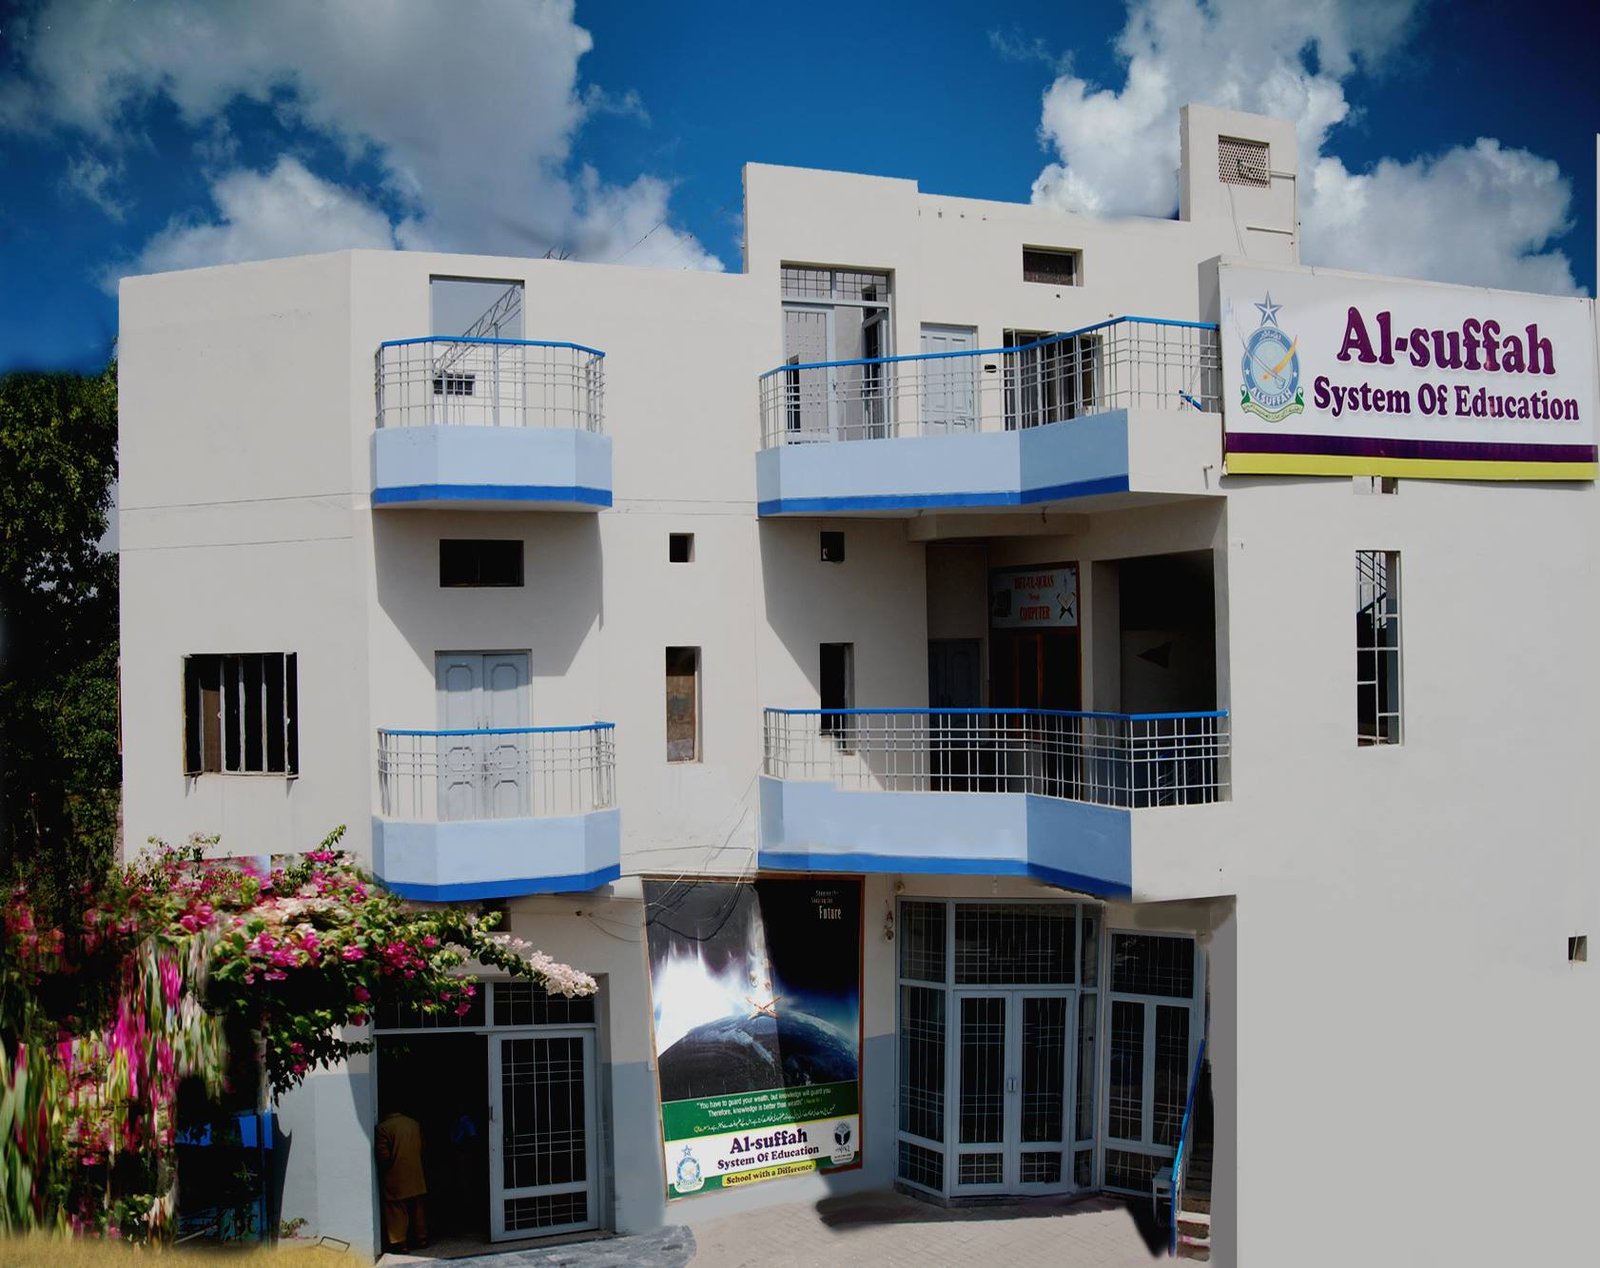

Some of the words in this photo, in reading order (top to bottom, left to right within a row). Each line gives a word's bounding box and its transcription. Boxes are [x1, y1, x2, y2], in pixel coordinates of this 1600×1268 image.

[1336, 306, 1557, 375] Al-suffah
[1313, 375, 1411, 418] System
[1417, 383, 1448, 416] Of
[1455, 385, 1580, 421] Education
[1020, 606, 1050, 620] COMPUTER
[818, 905, 842, 920] Future
[728, 1098, 741, 1107] guard
[742, 1097, 753, 1105] your
[733, 1105, 758, 1115] knowledge
[730, 1128, 808, 1155] Al-suffah
[717, 1155, 755, 1170] System
[756, 1152, 770, 1164] Of
[771, 1145, 820, 1161] Education
[726, 1173, 751, 1185] School
[753, 1171, 770, 1181] with
[777, 1163, 813, 1176] Difference
